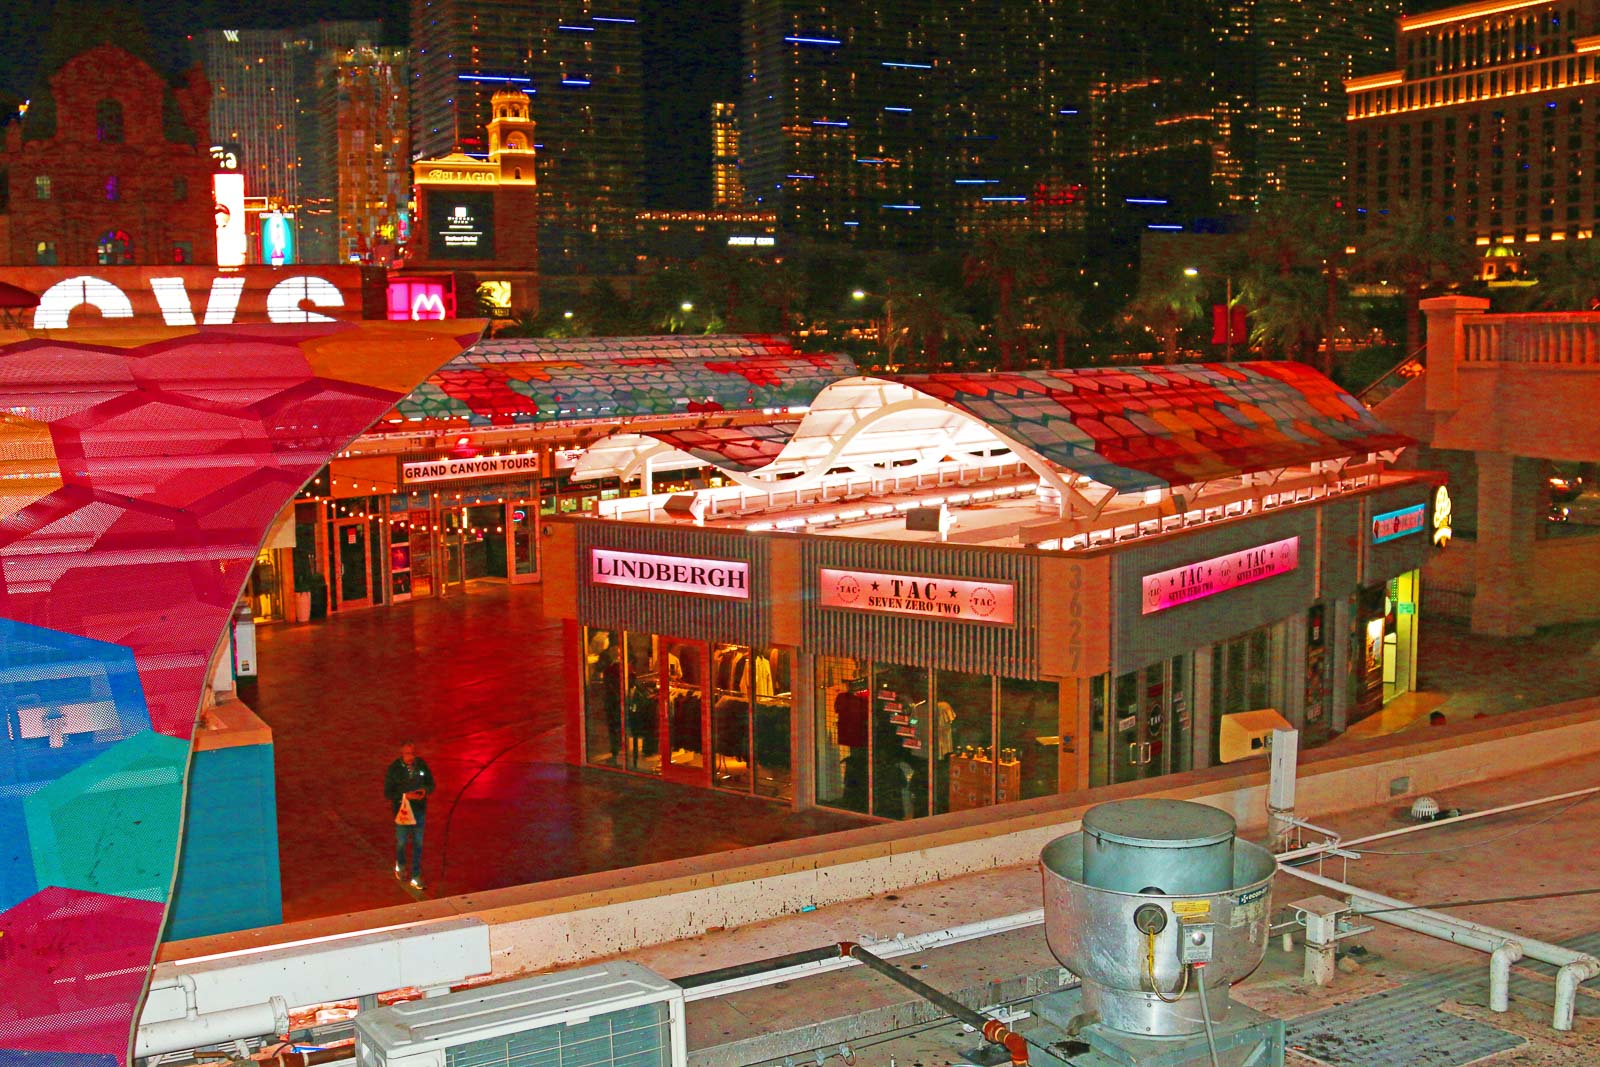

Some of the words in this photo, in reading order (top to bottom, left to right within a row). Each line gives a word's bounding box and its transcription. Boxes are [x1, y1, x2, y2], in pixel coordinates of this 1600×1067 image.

[429, 169, 495, 182] BELLAGIO
[405, 465, 447, 479] GRAND
[450, 460, 497, 474] CANYON
[501, 457, 536, 470] TOURS
[1246, 550, 1266, 569] TAC
[1265, 563, 1275, 574] TWO
[597, 557, 745, 589] LINDBERGH
[1180, 566, 1203, 588] TAC
[840, 586, 857, 594] TAC
[891, 579, 937, 600] TAC
[1168, 590, 1186, 601] SEVEN
[1187, 586, 1200, 597] ZERO
[1201, 582, 1214, 593] TWO
[868, 596, 901, 609] SEVEN
[905, 600, 933, 612] ZERO
[938, 602, 961, 614] TWO
[974, 597, 993, 606] TAC
[1069, 564, 1082, 673] 3627
